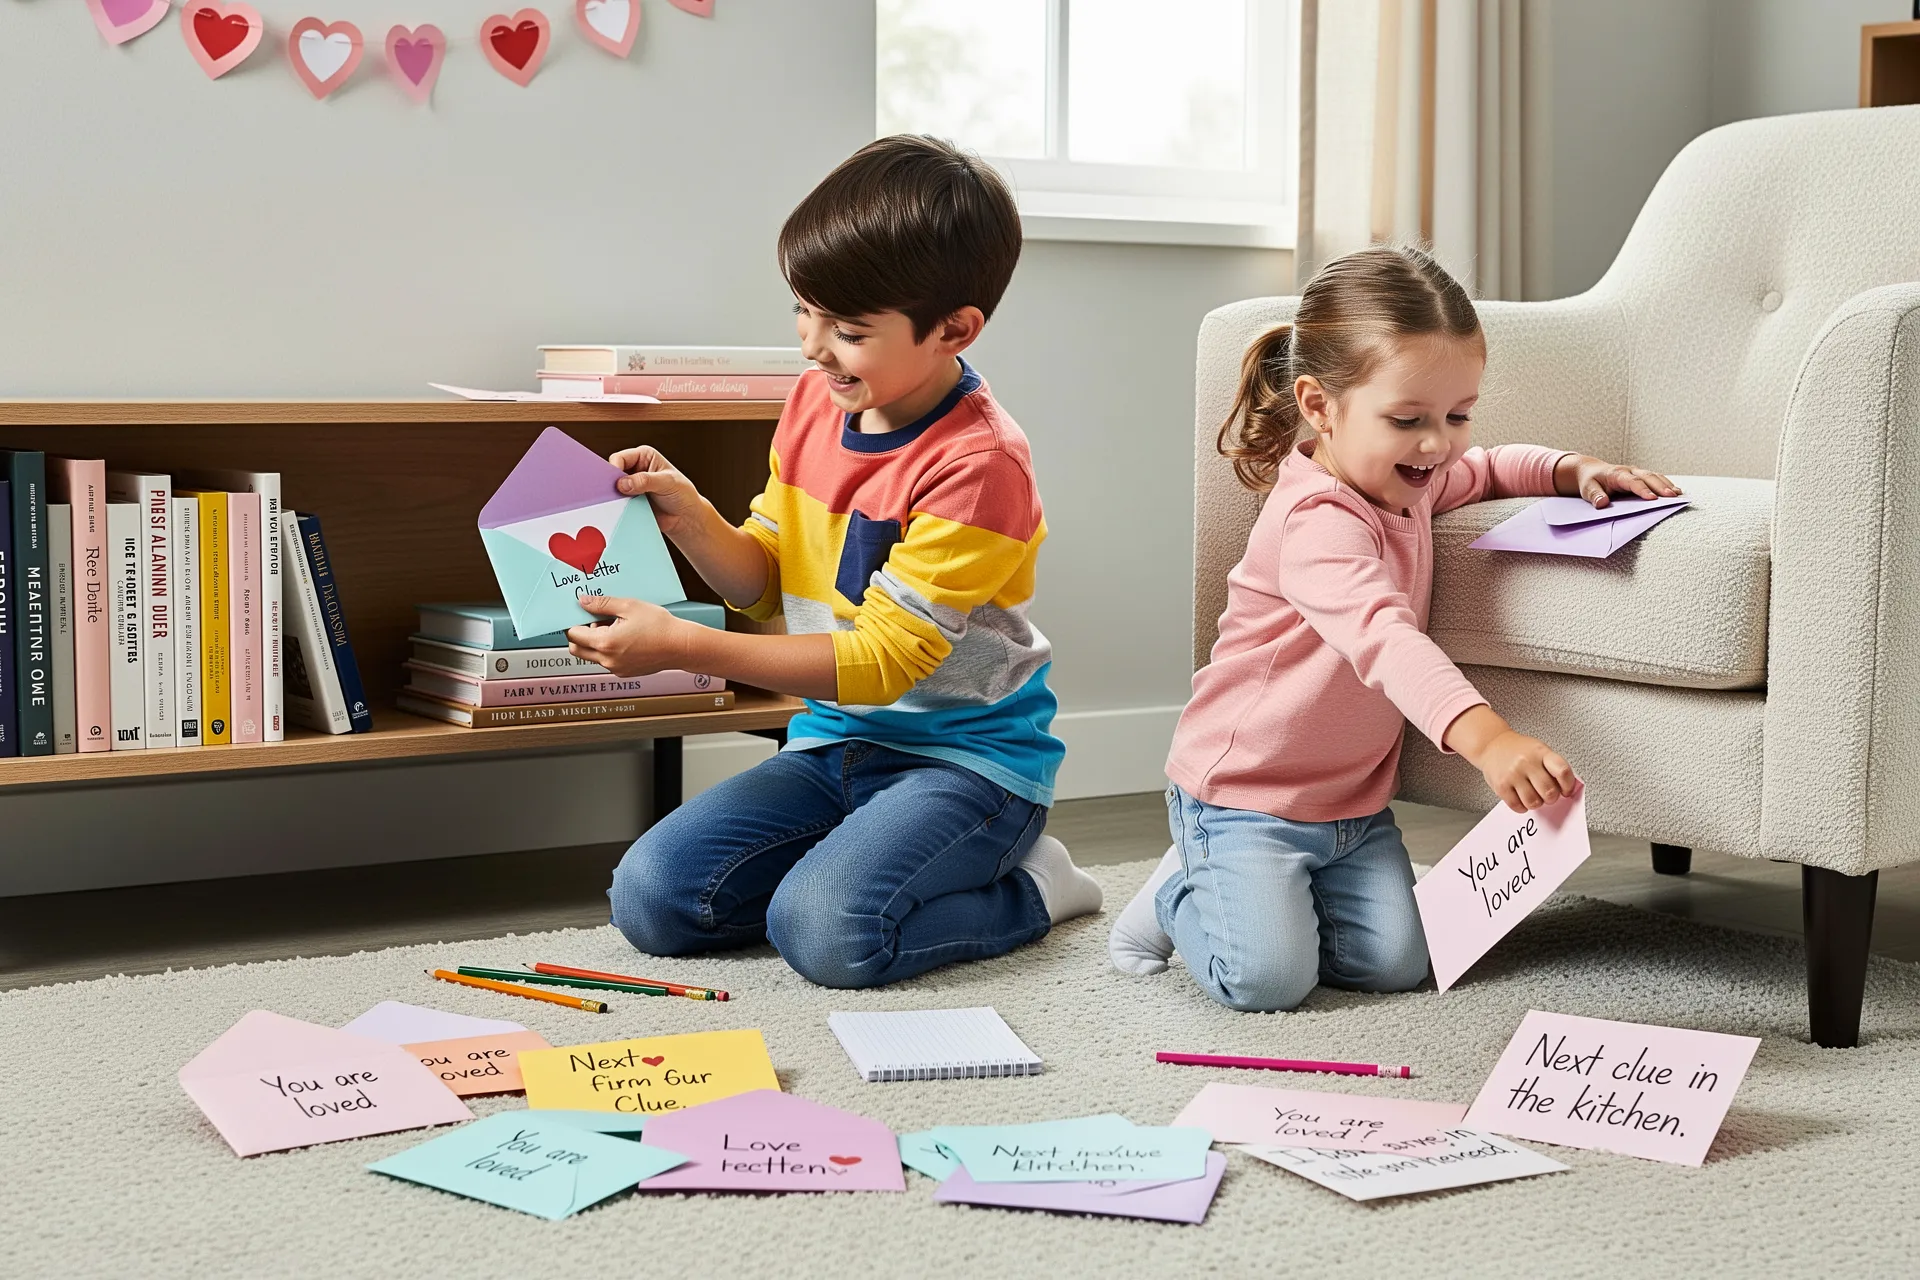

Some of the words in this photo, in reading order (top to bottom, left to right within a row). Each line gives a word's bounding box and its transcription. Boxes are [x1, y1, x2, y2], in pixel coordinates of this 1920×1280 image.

[551, 571, 581, 588] Love
[582, 560, 621, 581] Letter
[1458, 852, 1500, 892] You
[1507, 817, 1539, 854] are
[1481, 850, 1536, 918] loved
[420, 1055, 452, 1067] ou
[467, 1049, 511, 1061] are
[440, 1061, 504, 1081] oved
[569, 1048, 640, 1072] Next
[1525, 1032, 1605, 1076] Next
[1612, 1047, 1673, 1086] clue
[1688, 1063, 1719, 1092] in
[260, 1075, 325, 1097] You
[335, 1069, 379, 1087] are
[293, 1089, 378, 1118] loved
[614, 1093, 687, 1112] Clue.
[1506, 1076, 1556, 1114] the
[1567, 1084, 1685, 1138] kitchen.
[1274, 1106, 1321, 1123] You
[1340, 1118, 1385, 1129] are
[496, 1129, 542, 1155] You
[545, 1149, 588, 1165] are
[723, 1133, 802, 1152] Love
[992, 1144, 1061, 1158] Next
[465, 1151, 552, 1181] loved
